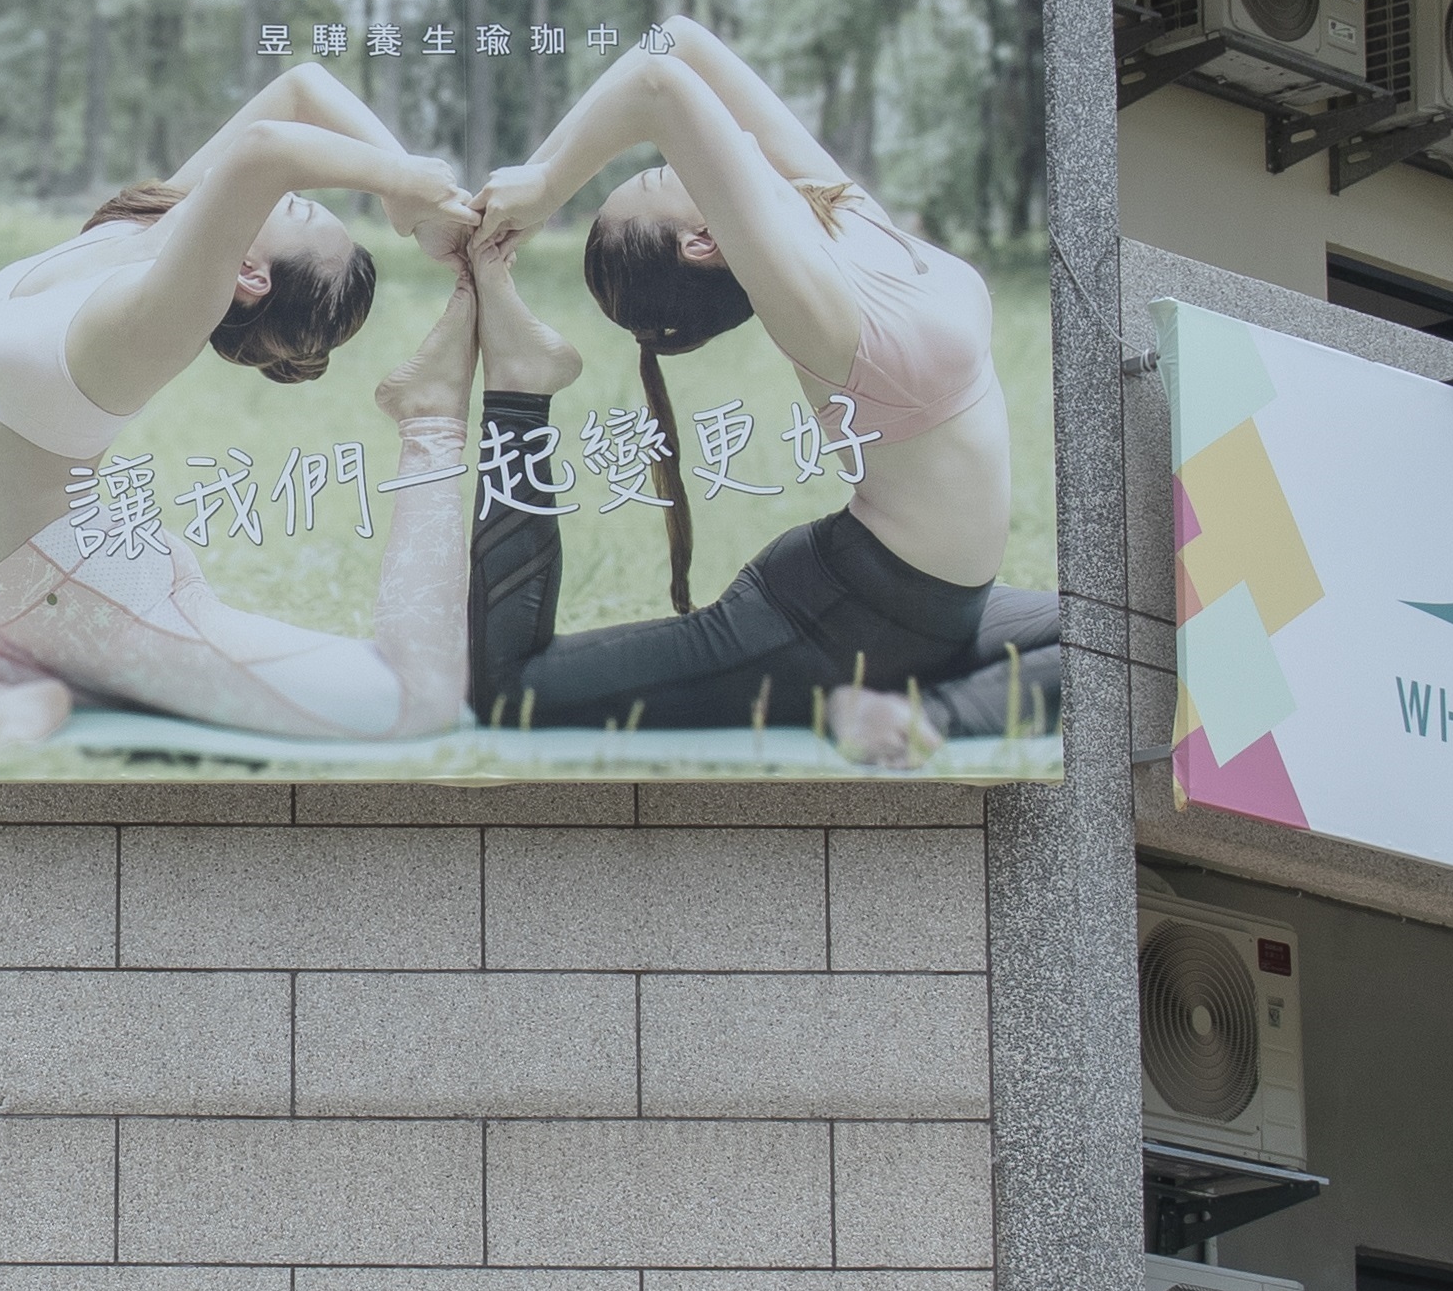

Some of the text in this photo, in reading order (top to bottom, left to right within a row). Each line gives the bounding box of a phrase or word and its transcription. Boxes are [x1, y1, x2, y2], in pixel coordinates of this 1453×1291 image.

[256, 23, 675, 56] 昱驊養生瑜珈中心
[63, 392, 883, 561] 讓我們一起變更好
